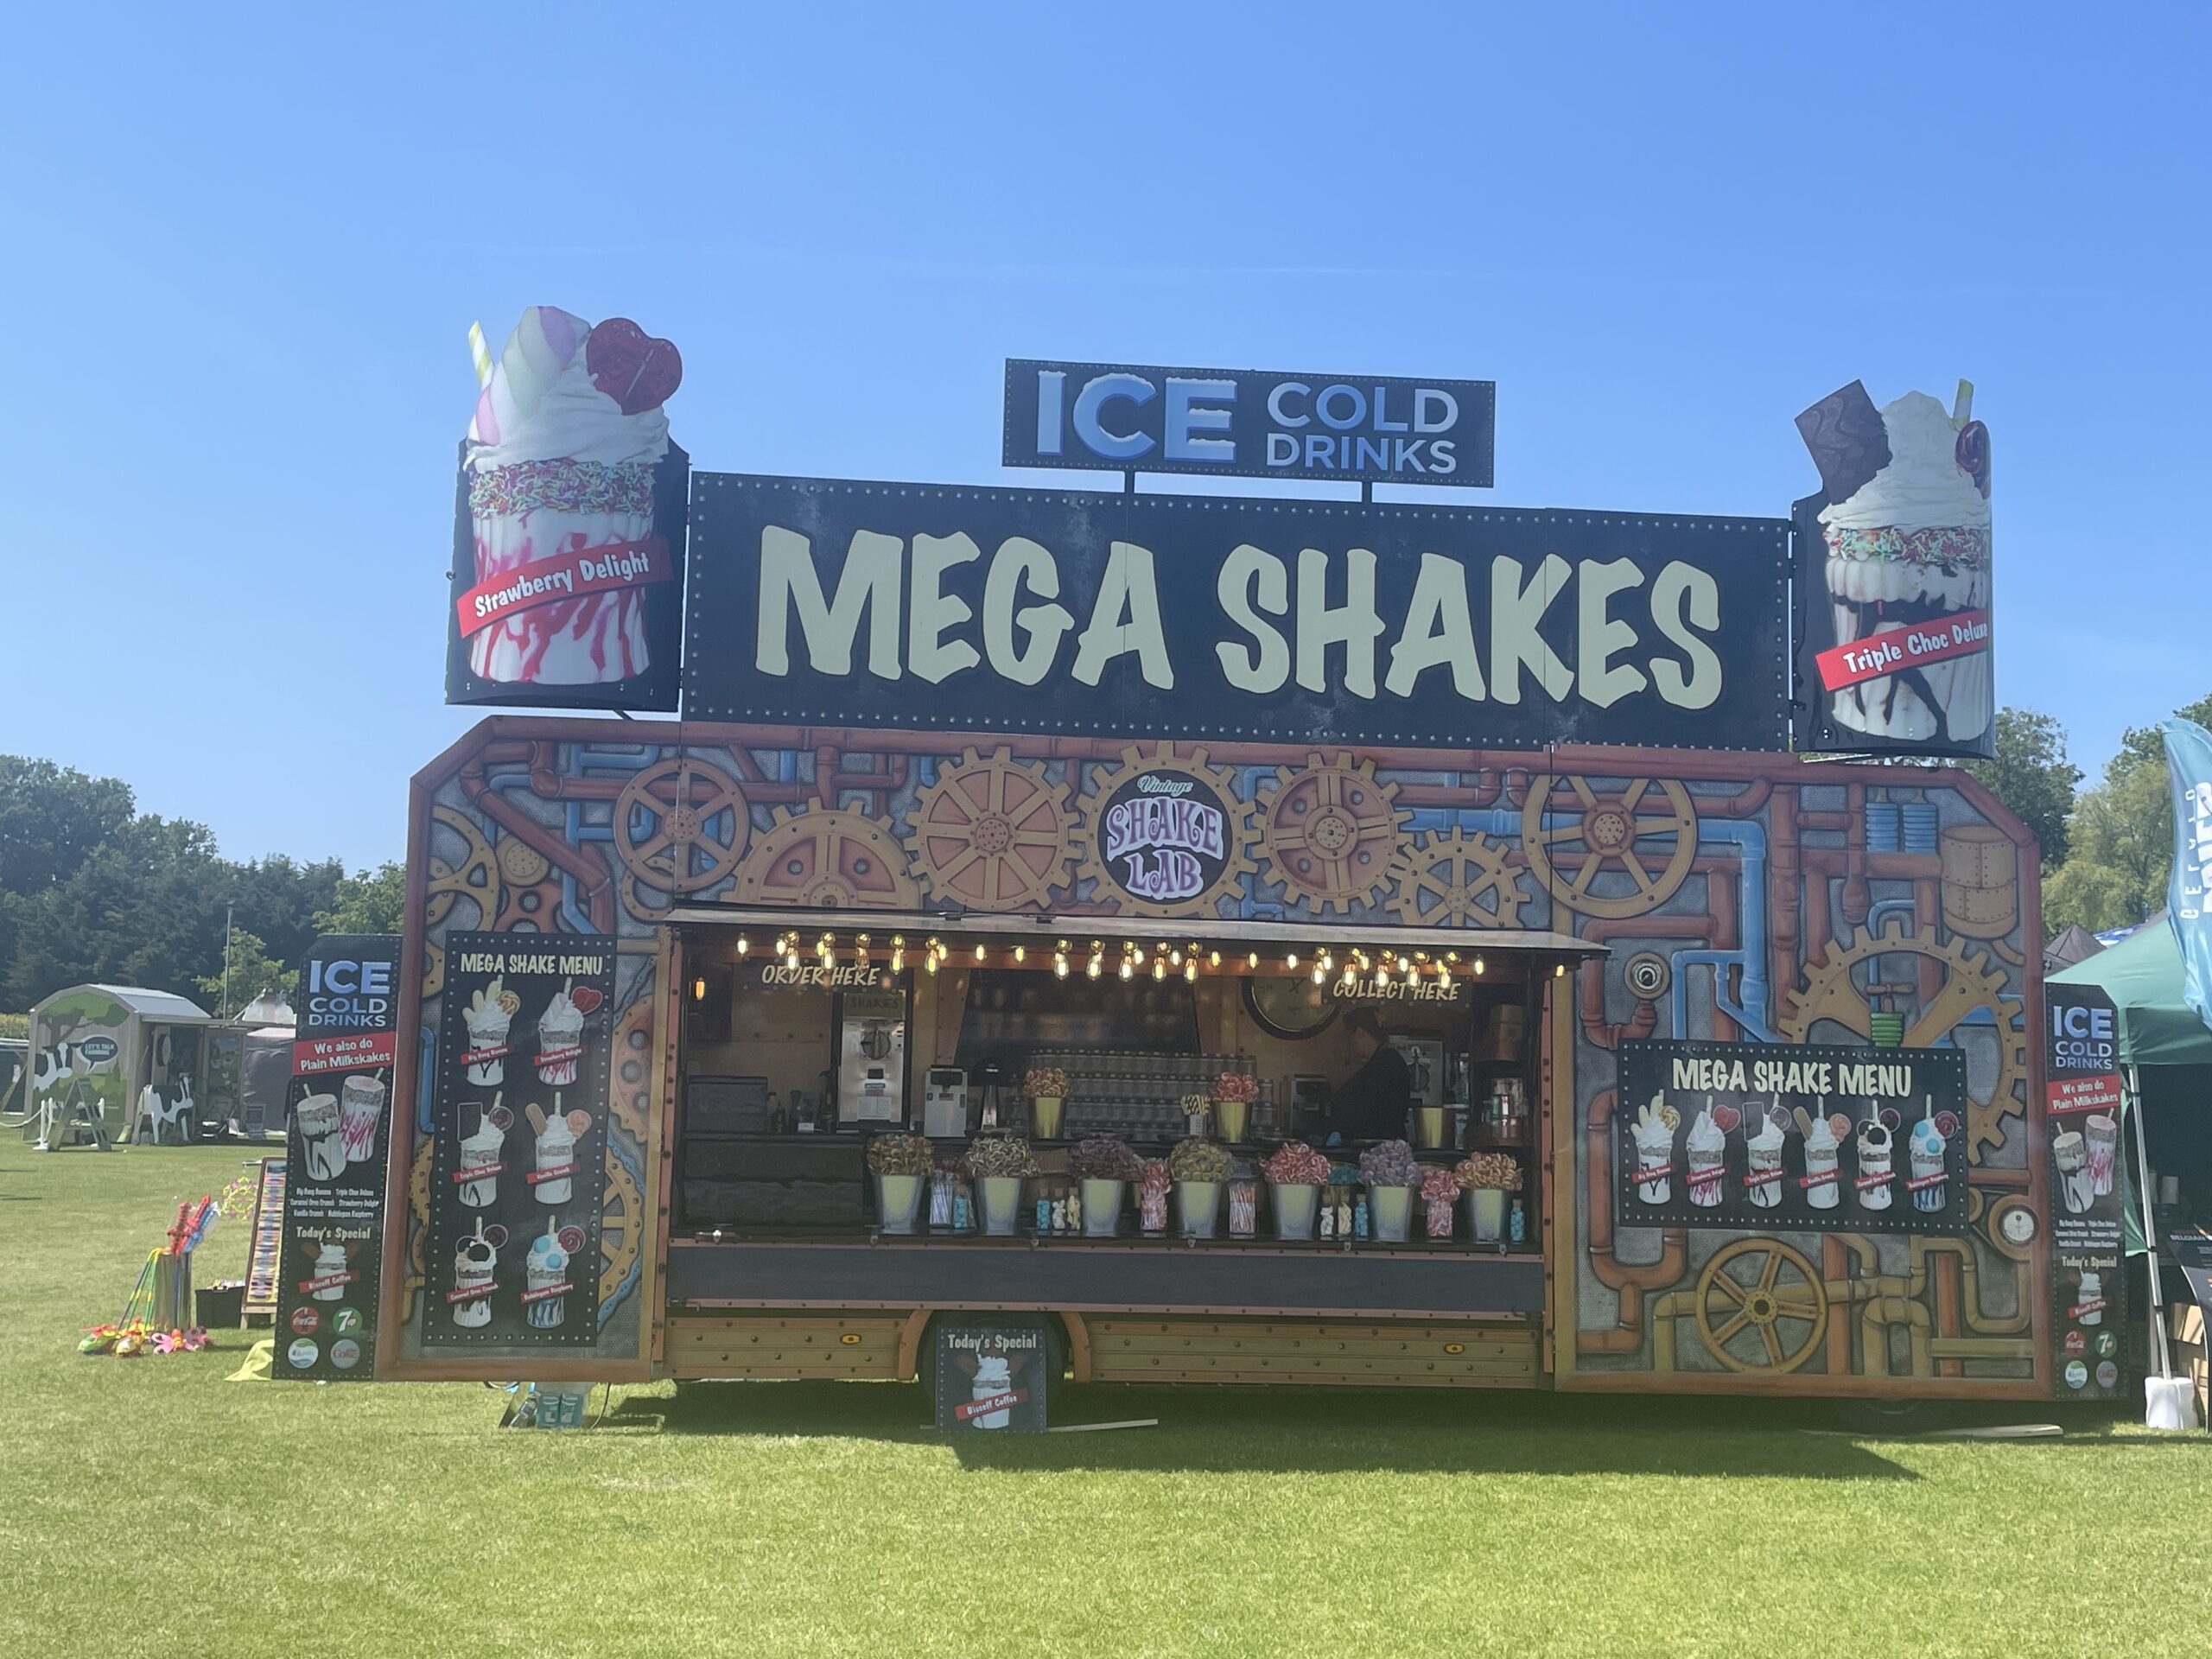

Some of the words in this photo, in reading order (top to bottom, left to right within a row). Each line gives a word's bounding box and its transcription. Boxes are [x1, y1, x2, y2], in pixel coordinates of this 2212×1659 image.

[1037, 370, 1237, 462] ICE
[1267, 382, 1459, 433] COLD
[1267, 434, 1457, 474] DRINKS
[475, 569, 573, 618] Strawberry
[579, 550, 649, 582] Delight
[754, 524, 1174, 690] MEGA
[1216, 543, 1722, 709] SHAKES
[1843, 642, 1902, 673] Triple
[1907, 632, 1949, 656] Choc
[1137, 775, 1193, 797] Vintage
[1107, 796, 1223, 862] SHAKE
[1123, 849, 1204, 900] LAB
[461, 953, 505, 973] MEGA
[509, 954, 556, 975] SHAKE
[559, 956, 603, 976] MENU
[761, 965, 825, 985] ORDER
[830, 966, 880, 986] HERE
[309, 960, 391, 995] ICE
[1333, 979, 1407, 1000] COLLECT
[1414, 981, 1462, 1001] HERE
[309, 997, 388, 1014] COLD
[308, 1014, 386, 1027] DRINKS
[2053, 1006, 2113, 1039] ICE
[315, 1043, 332, 1054] We
[335, 1040, 356, 1052] also
[359, 1038, 372, 1049] do
[2056, 1040, 2113, 1057] COLD
[300, 1059, 327, 1071] Plain
[2056, 1056, 2113, 1070] DRINKS
[1673, 1058, 1748, 1091] MEGA
[1753, 1059, 1833, 1095] SHAKE
[1839, 1063, 1911, 1097] MENU
[2062, 1084, 2075, 1095] We
[2077, 1081, 2093, 1092] also
[2094, 1079, 2105, 1090] do
[2052, 1099, 2073, 1109] Plain
[296, 1226, 331, 1242] Today's
[334, 1227, 371, 1242] Special
[2091, 1255, 2117, 1270] Special
[948, 1333, 990, 1352] Today's
[995, 1333, 1037, 1352] Special
[967, 1400, 993, 1415] Biscoff
[995, 1395, 1017, 1407] Coffee
